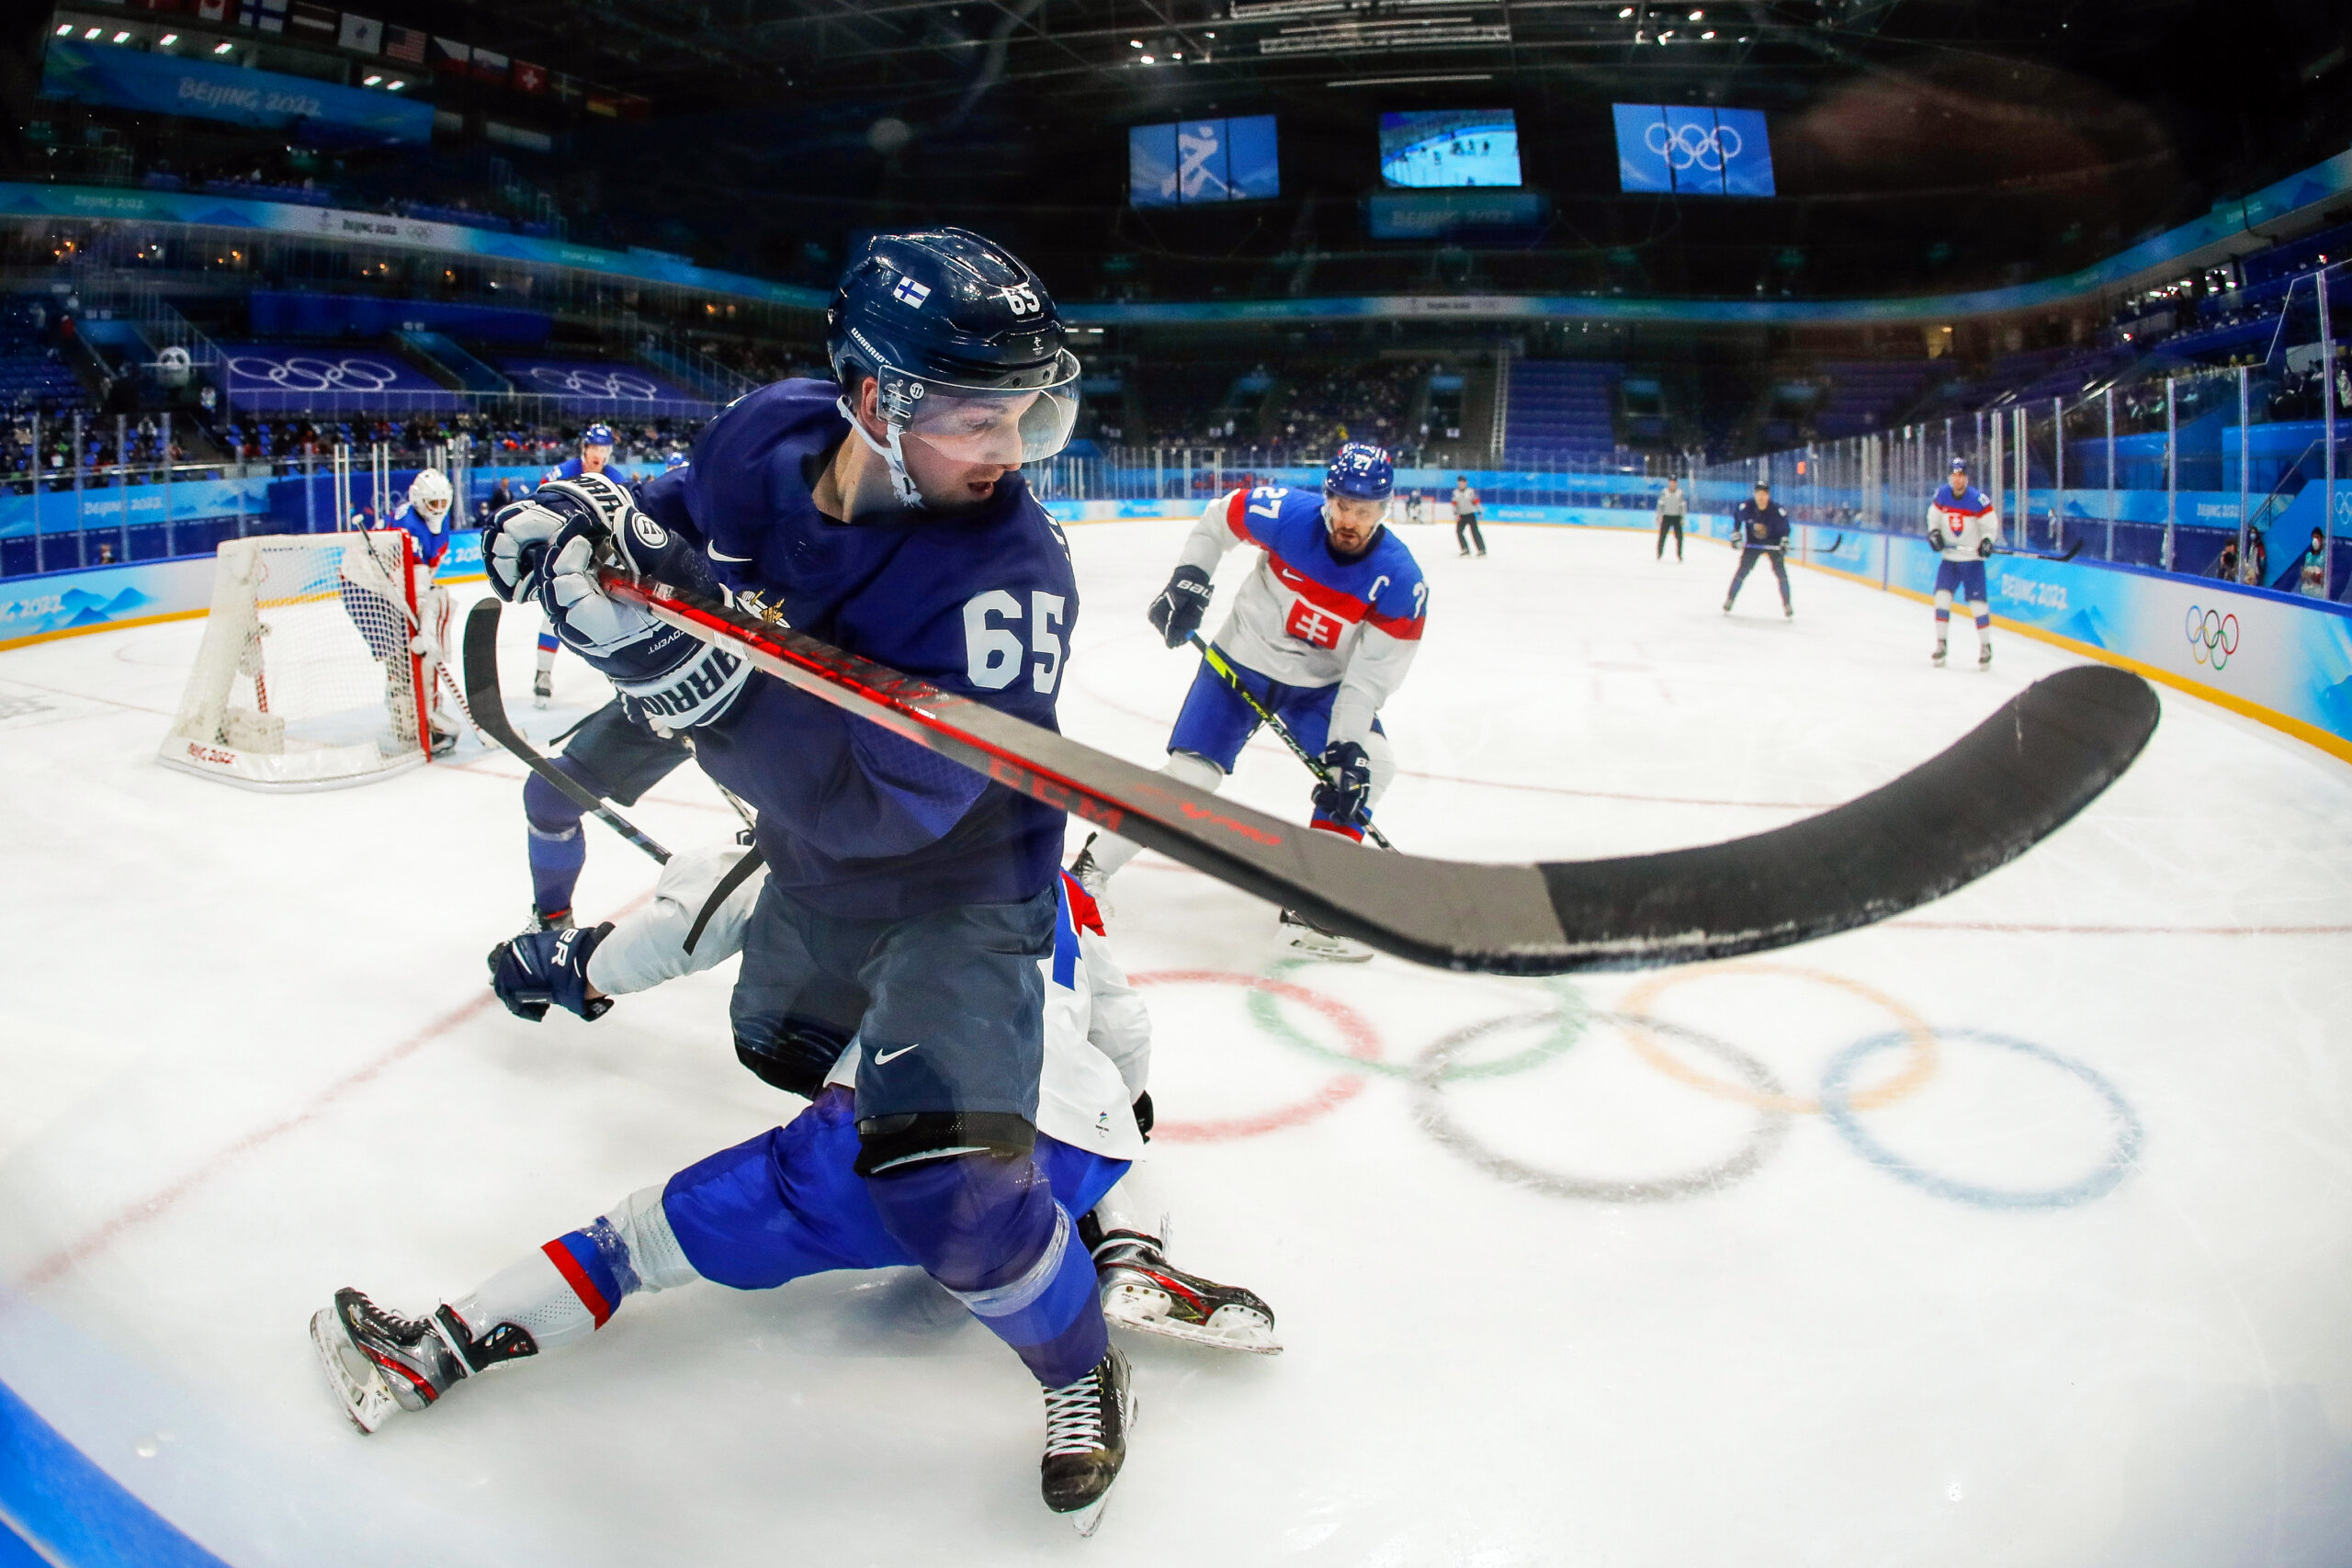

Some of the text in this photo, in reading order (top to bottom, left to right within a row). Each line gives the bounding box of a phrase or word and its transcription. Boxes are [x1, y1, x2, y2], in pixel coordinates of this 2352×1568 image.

[265, 91, 322, 118] 2022
[1001, 282, 1041, 316] 65
[1351, 457, 1374, 471] 27
[1249, 486, 1289, 520] 27
[454, 547, 482, 564] 202
[1368, 574, 1390, 603] C
[18, 594, 67, 619] 2022
[962, 589, 1066, 694] 65
[988, 753, 1125, 834] CCM
